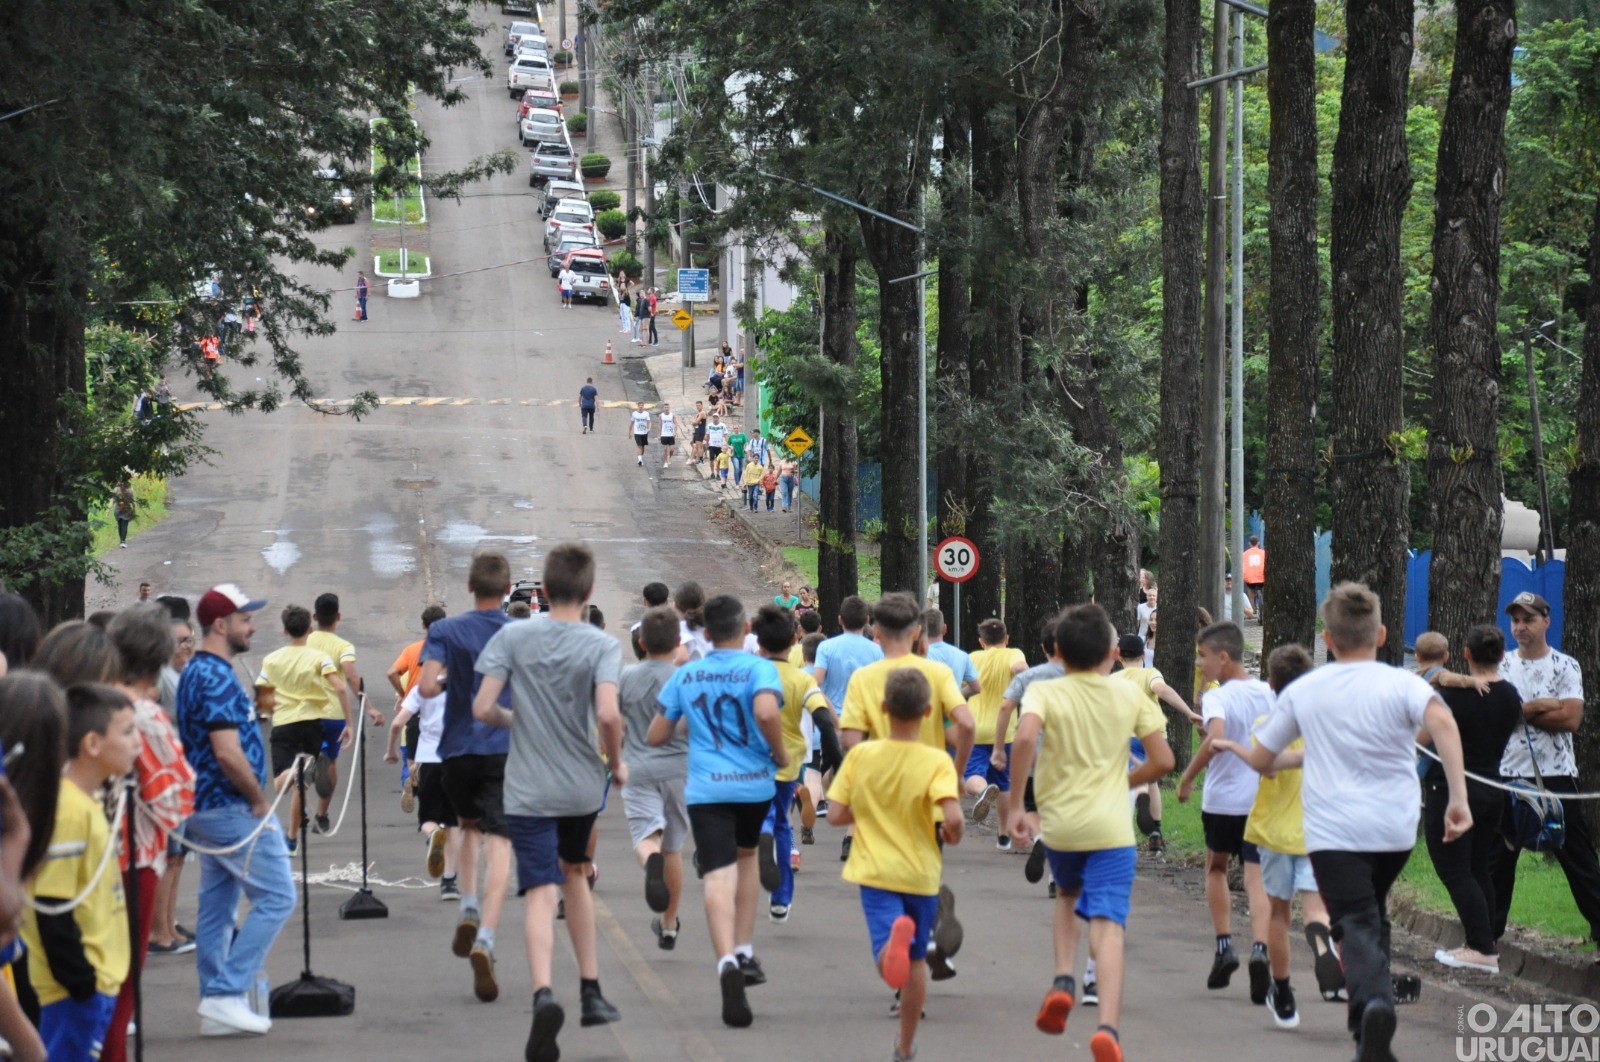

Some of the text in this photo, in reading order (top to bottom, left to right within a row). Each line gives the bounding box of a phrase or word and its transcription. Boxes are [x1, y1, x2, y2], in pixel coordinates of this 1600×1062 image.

[944, 548, 970, 566] 30
[692, 692, 749, 750] 10
[710, 766, 770, 782] Unimed
